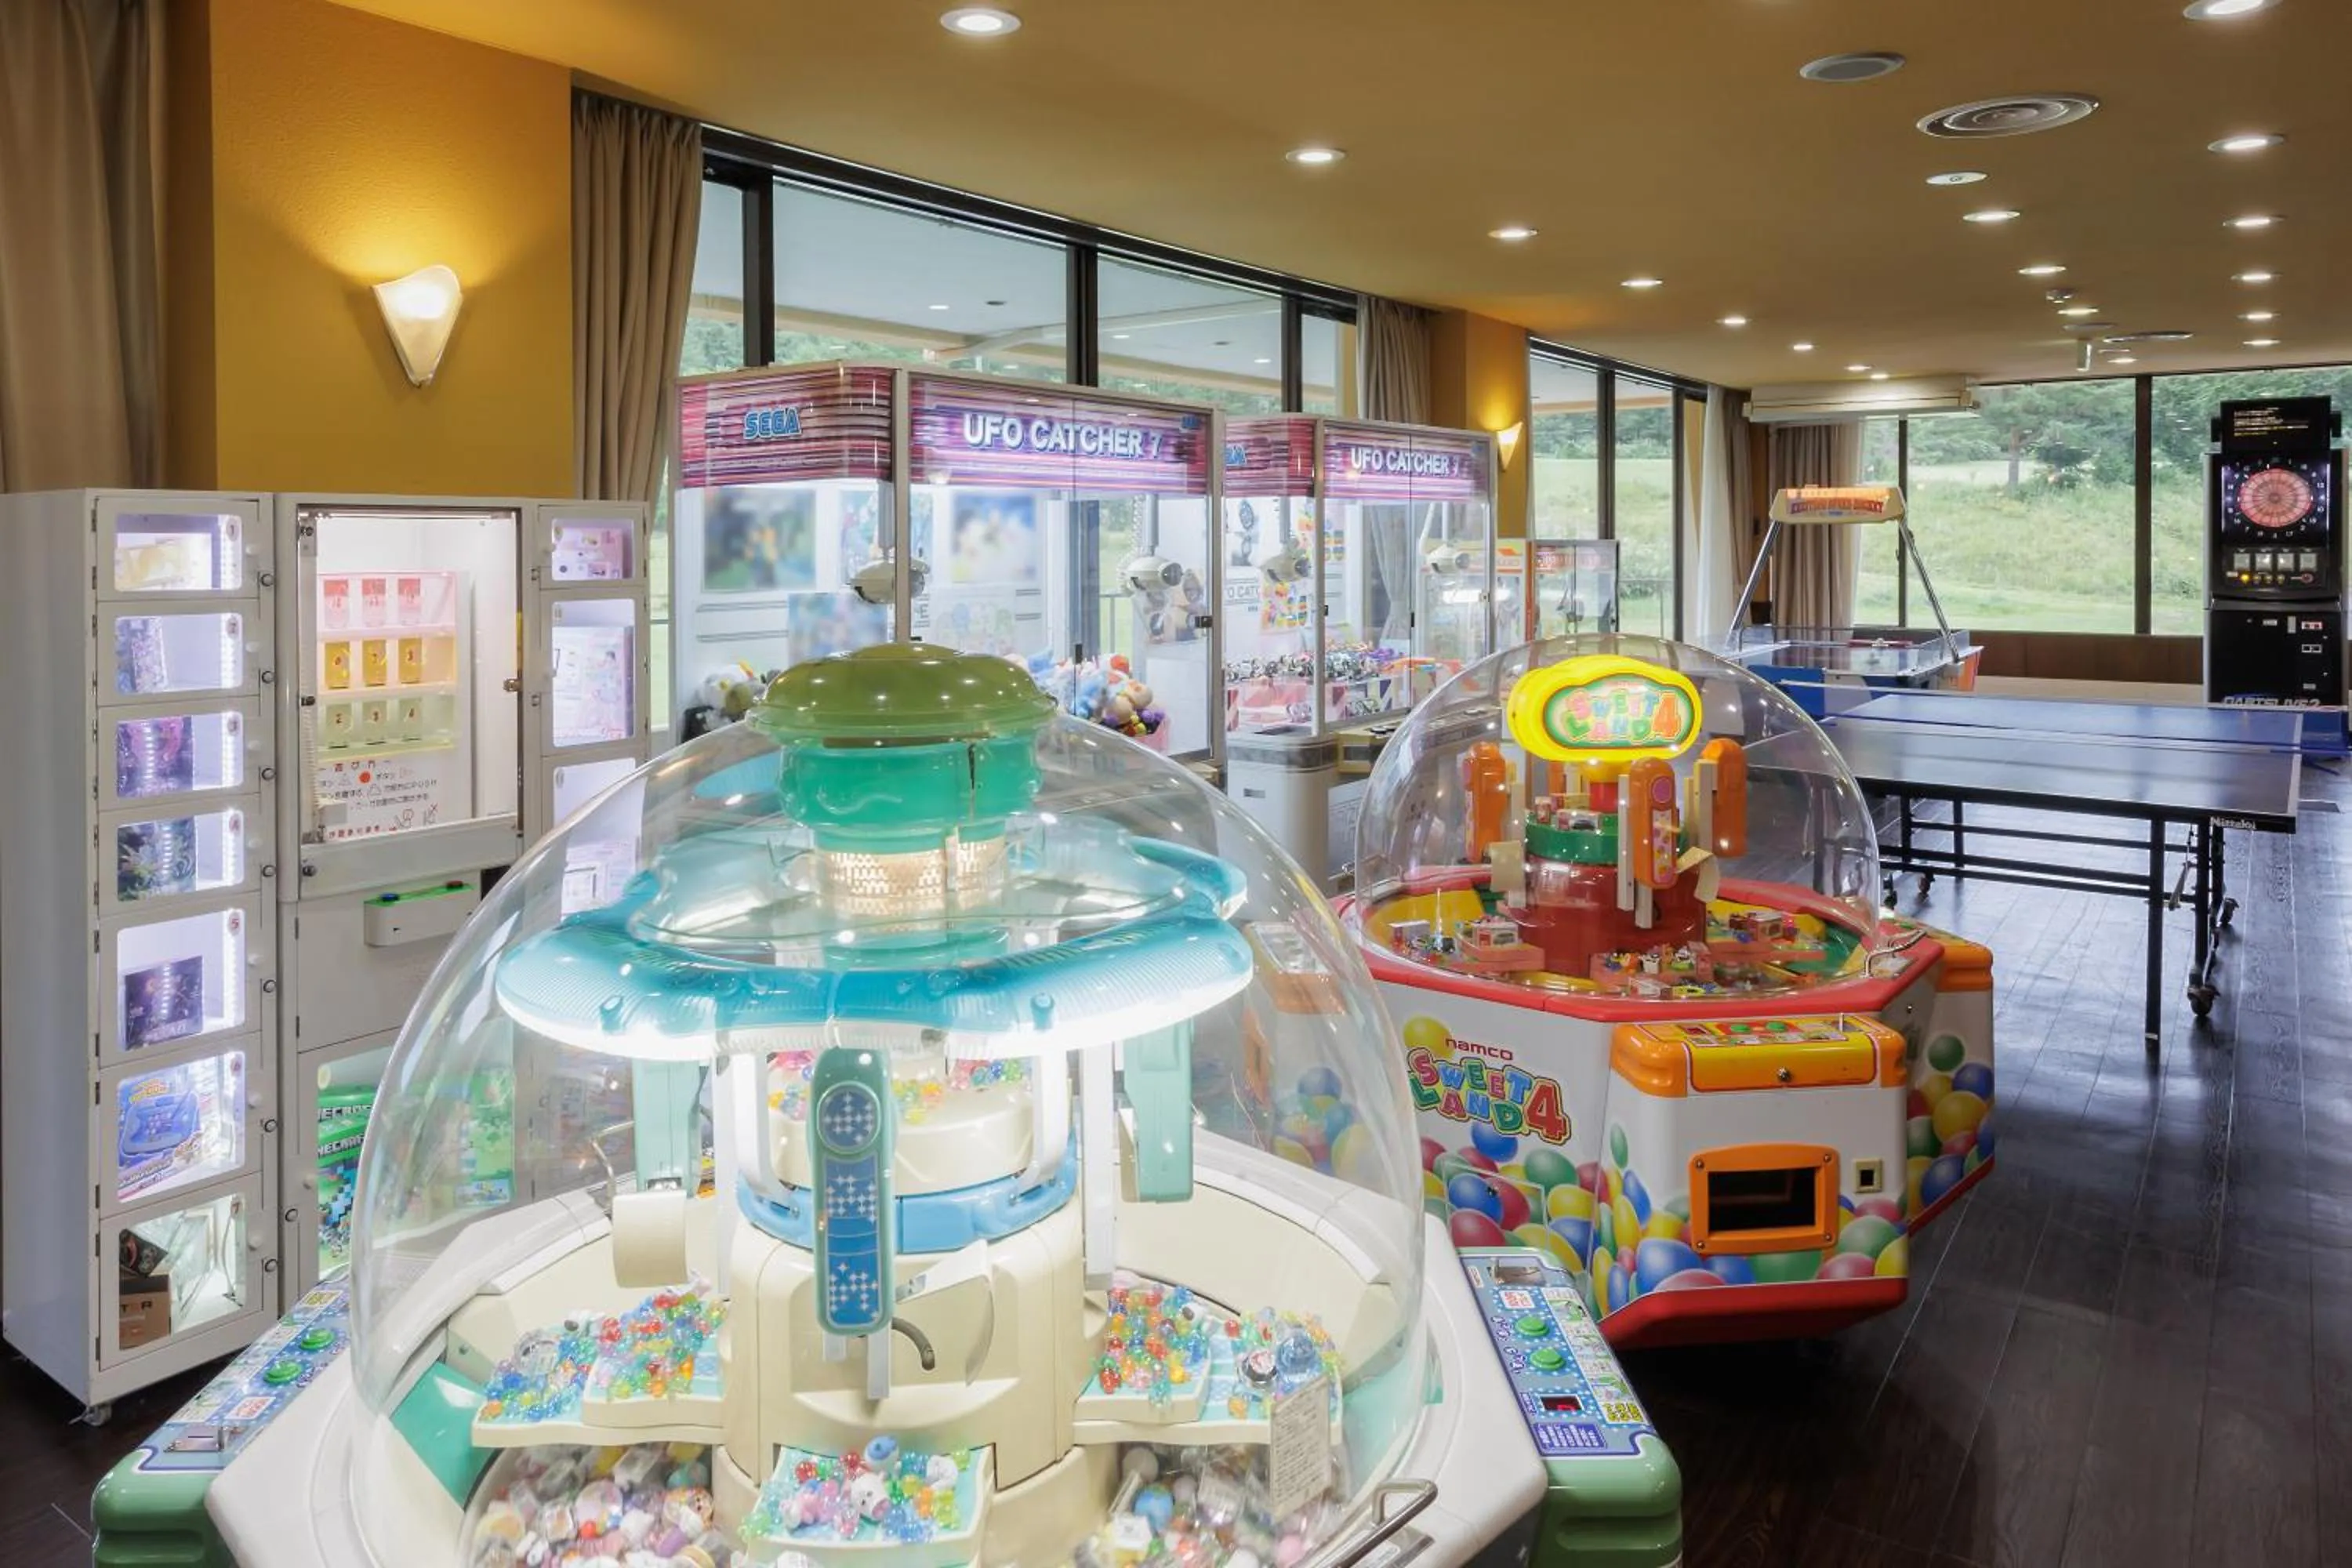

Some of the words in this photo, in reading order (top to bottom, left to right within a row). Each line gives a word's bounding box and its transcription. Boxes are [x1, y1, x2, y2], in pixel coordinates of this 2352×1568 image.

[743, 407, 801, 438] SEGA
[964, 414, 1023, 448] UFO
[1031, 419, 1143, 458] CATCHER
[1351, 447, 1383, 471] UFO
[1388, 451, 1449, 476] CATCHER
[1564, 712, 1651, 742] LAND
[1566, 688, 1660, 720] SWEET
[1652, 691, 1681, 739] 4
[1445, 1037, 1514, 1061] namco
[1409, 1073, 1523, 1131] LAND
[1413, 1052, 1534, 1105] SWEET
[1526, 1083, 1567, 1141] 4
